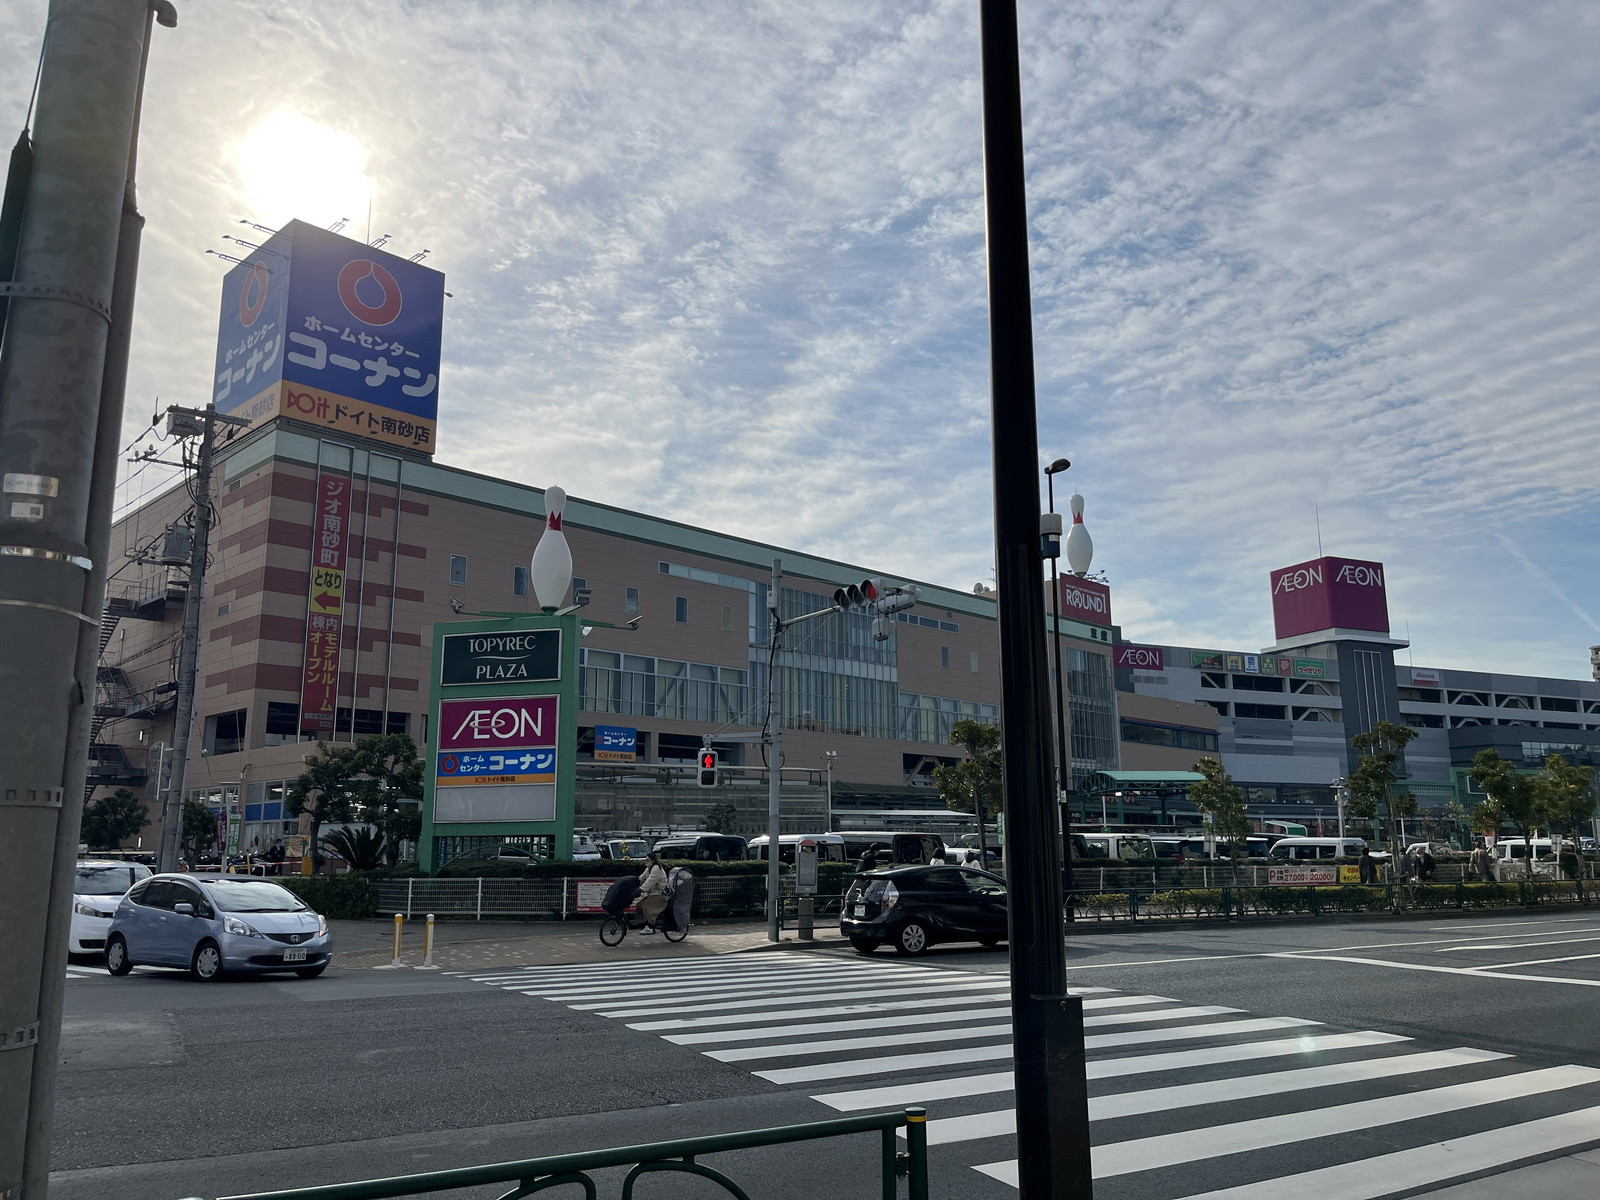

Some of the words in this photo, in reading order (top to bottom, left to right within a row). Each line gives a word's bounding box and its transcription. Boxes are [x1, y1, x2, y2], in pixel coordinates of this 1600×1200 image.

[225, 322, 276, 365] ホームセンター
[304, 316, 420, 359] ホームセンター
[216, 334, 281, 402] コーナン
[288, 331, 437, 398] コーナン
[335, 403, 430, 443] ドイト南砂店
[320, 480, 344, 567] ジオ南砂町
[314, 570, 342, 590] となり
[1066, 588, 1107, 614] ROUND1
[311, 615, 338, 633] 棟内
[468, 635, 536, 653] TOPYREC
[307, 632, 323, 684] オープン
[320, 632, 337, 712] モデルルーム
[476, 663, 528, 679] PLAZA
[1297, 666, 1323, 676] サイゼリヤ
[604, 736, 634, 746] コーナン
[460, 764, 487, 772] センター
[462, 755, 485, 763] ホーム
[489, 753, 553, 771] コーナン
[1269, 869, 1276, 881] P
